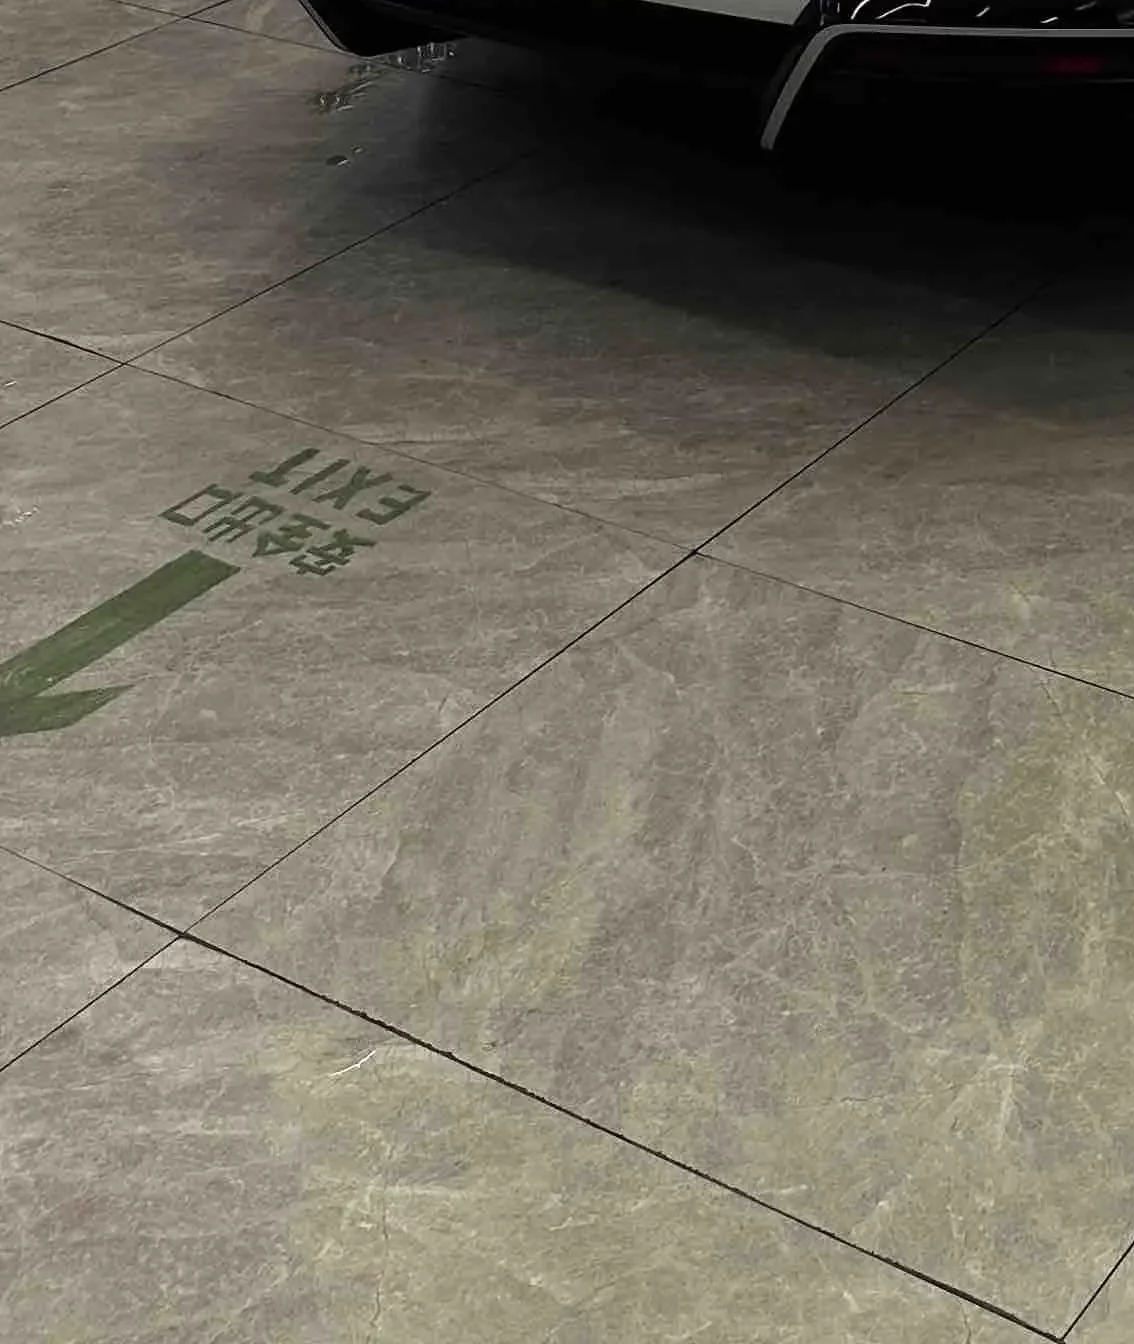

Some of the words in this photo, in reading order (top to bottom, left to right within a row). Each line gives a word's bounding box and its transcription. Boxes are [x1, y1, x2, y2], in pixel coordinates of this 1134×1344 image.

[158, 483, 378, 576] 安全出口
[249, 447, 431, 526] EXIT
